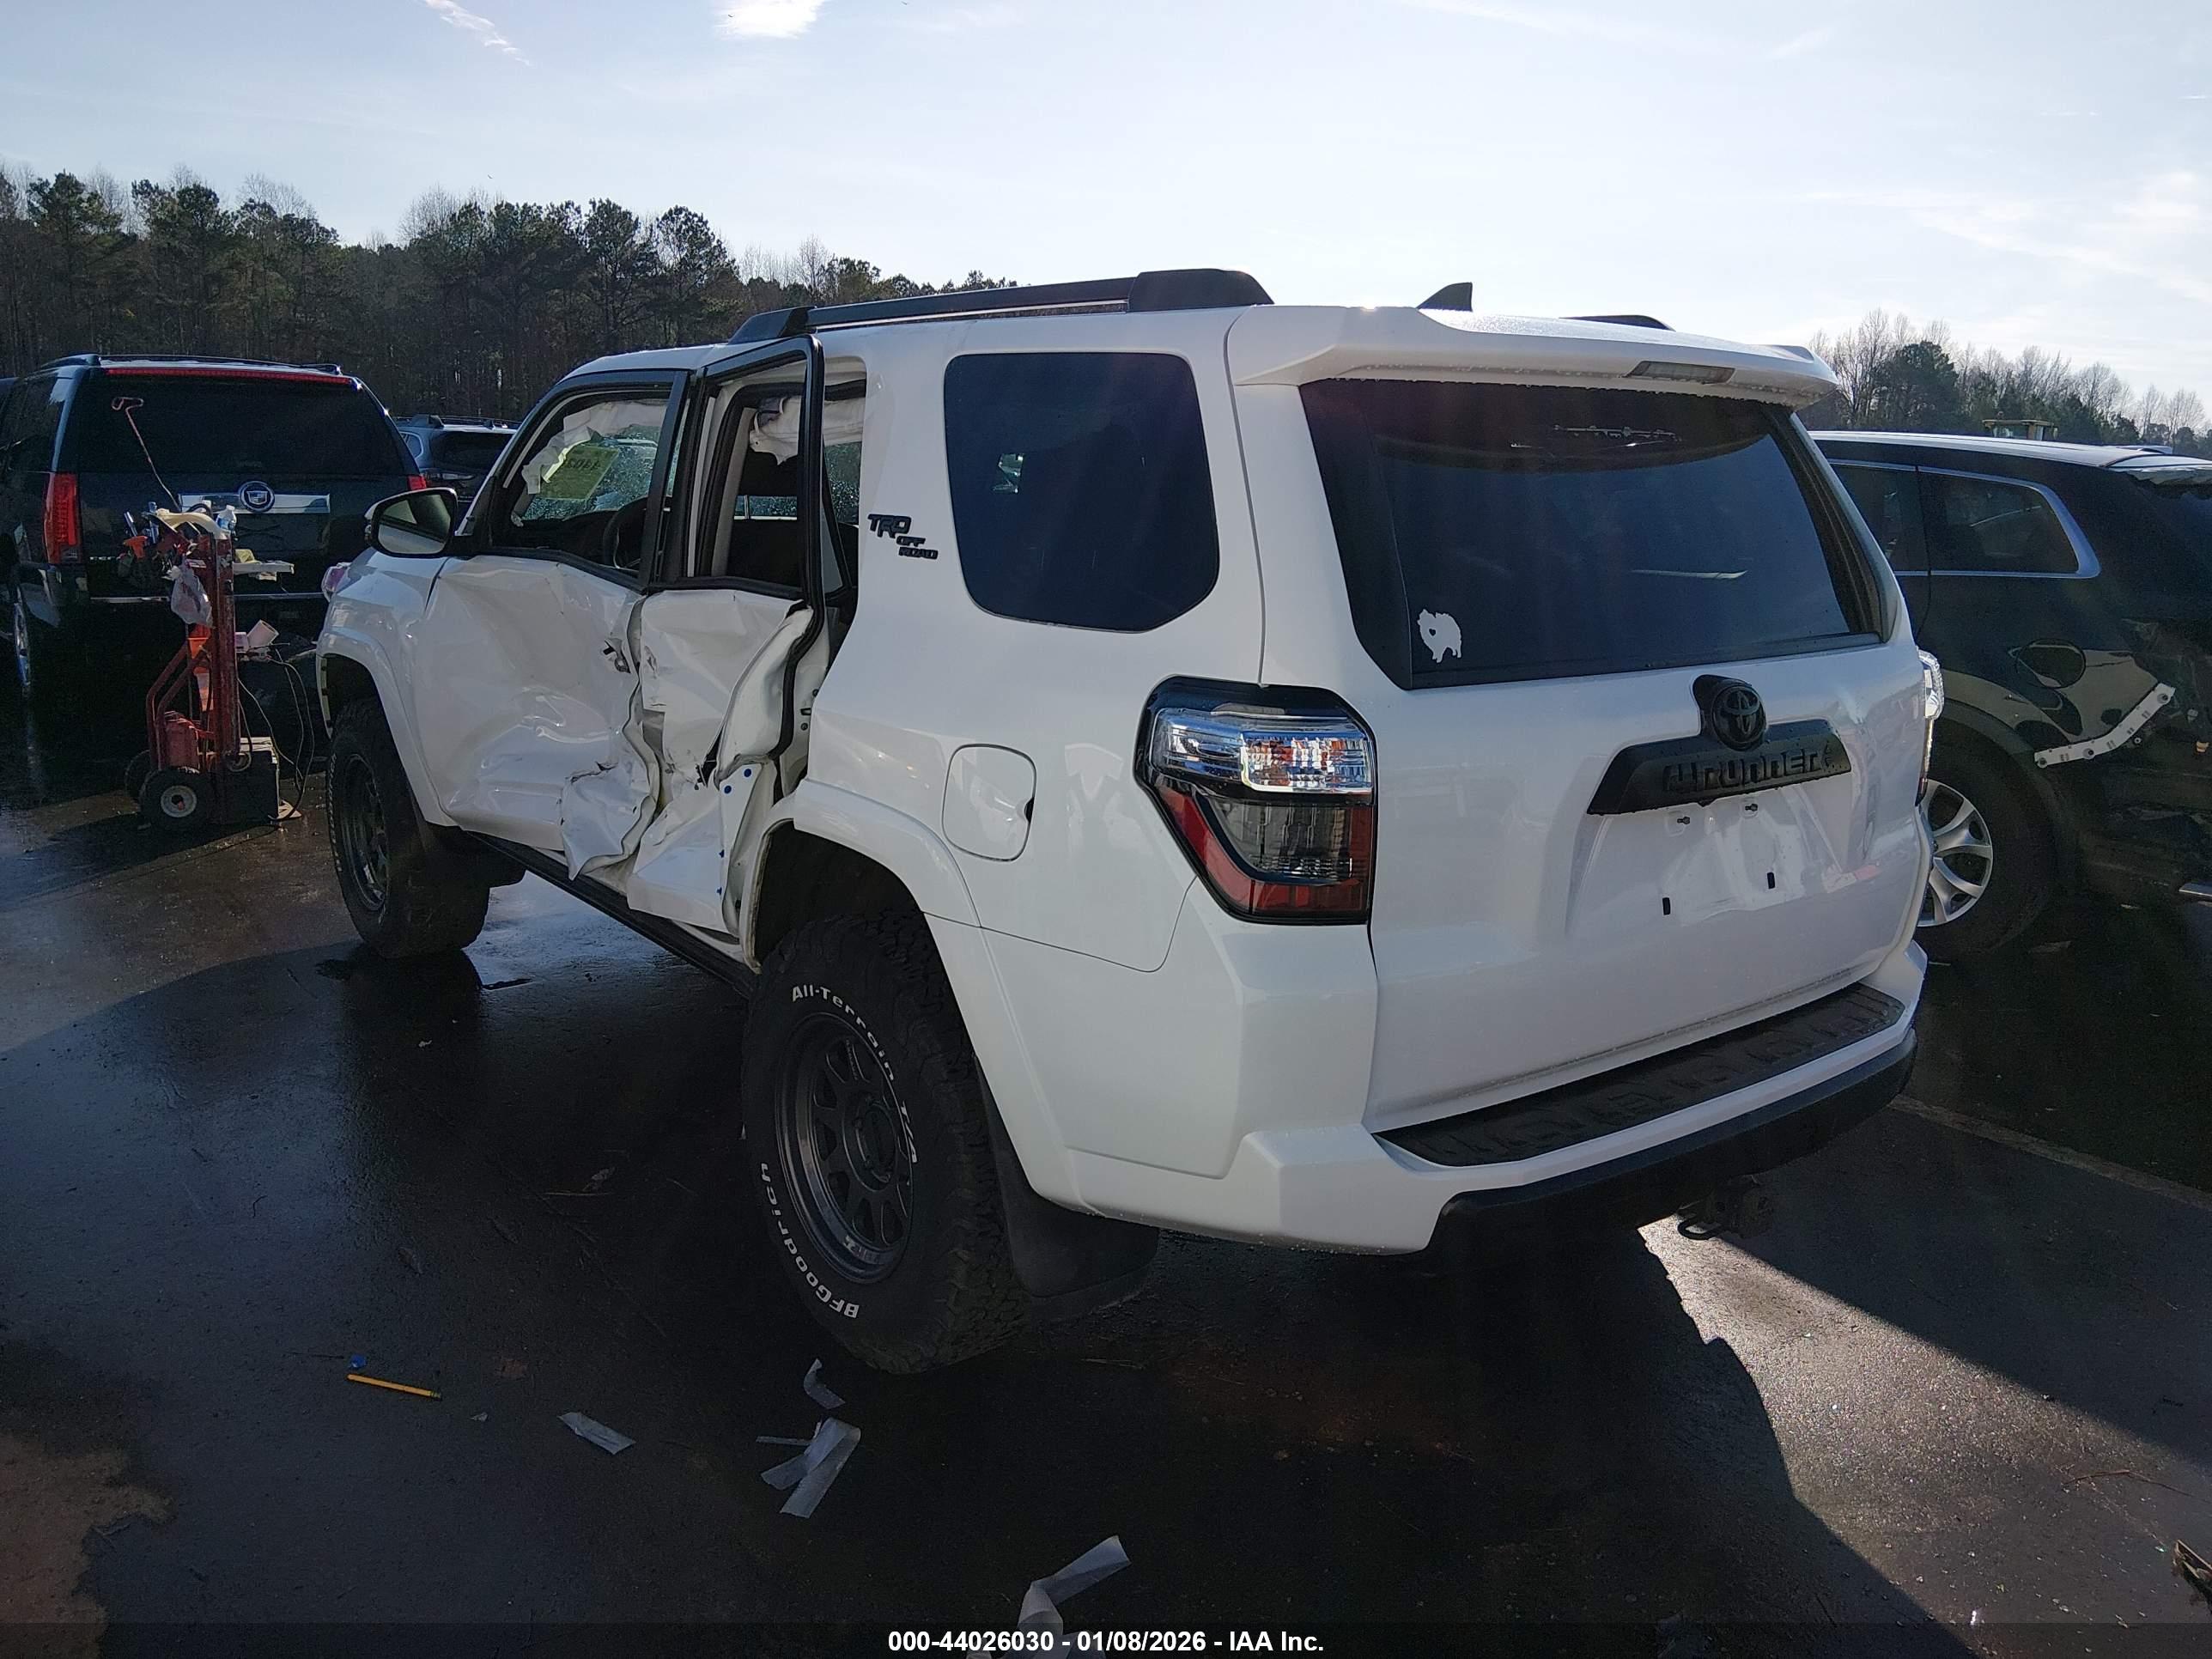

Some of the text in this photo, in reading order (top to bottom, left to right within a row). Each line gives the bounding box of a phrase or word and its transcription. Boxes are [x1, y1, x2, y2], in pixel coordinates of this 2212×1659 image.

[867, 514, 912, 538] TRD
[896, 536, 926, 547] OFF
[898, 547, 939, 560] ROAD
[791, 983, 919, 1165] All-Terrain T/A
[759, 1162, 860, 1319] BFGoodrich
